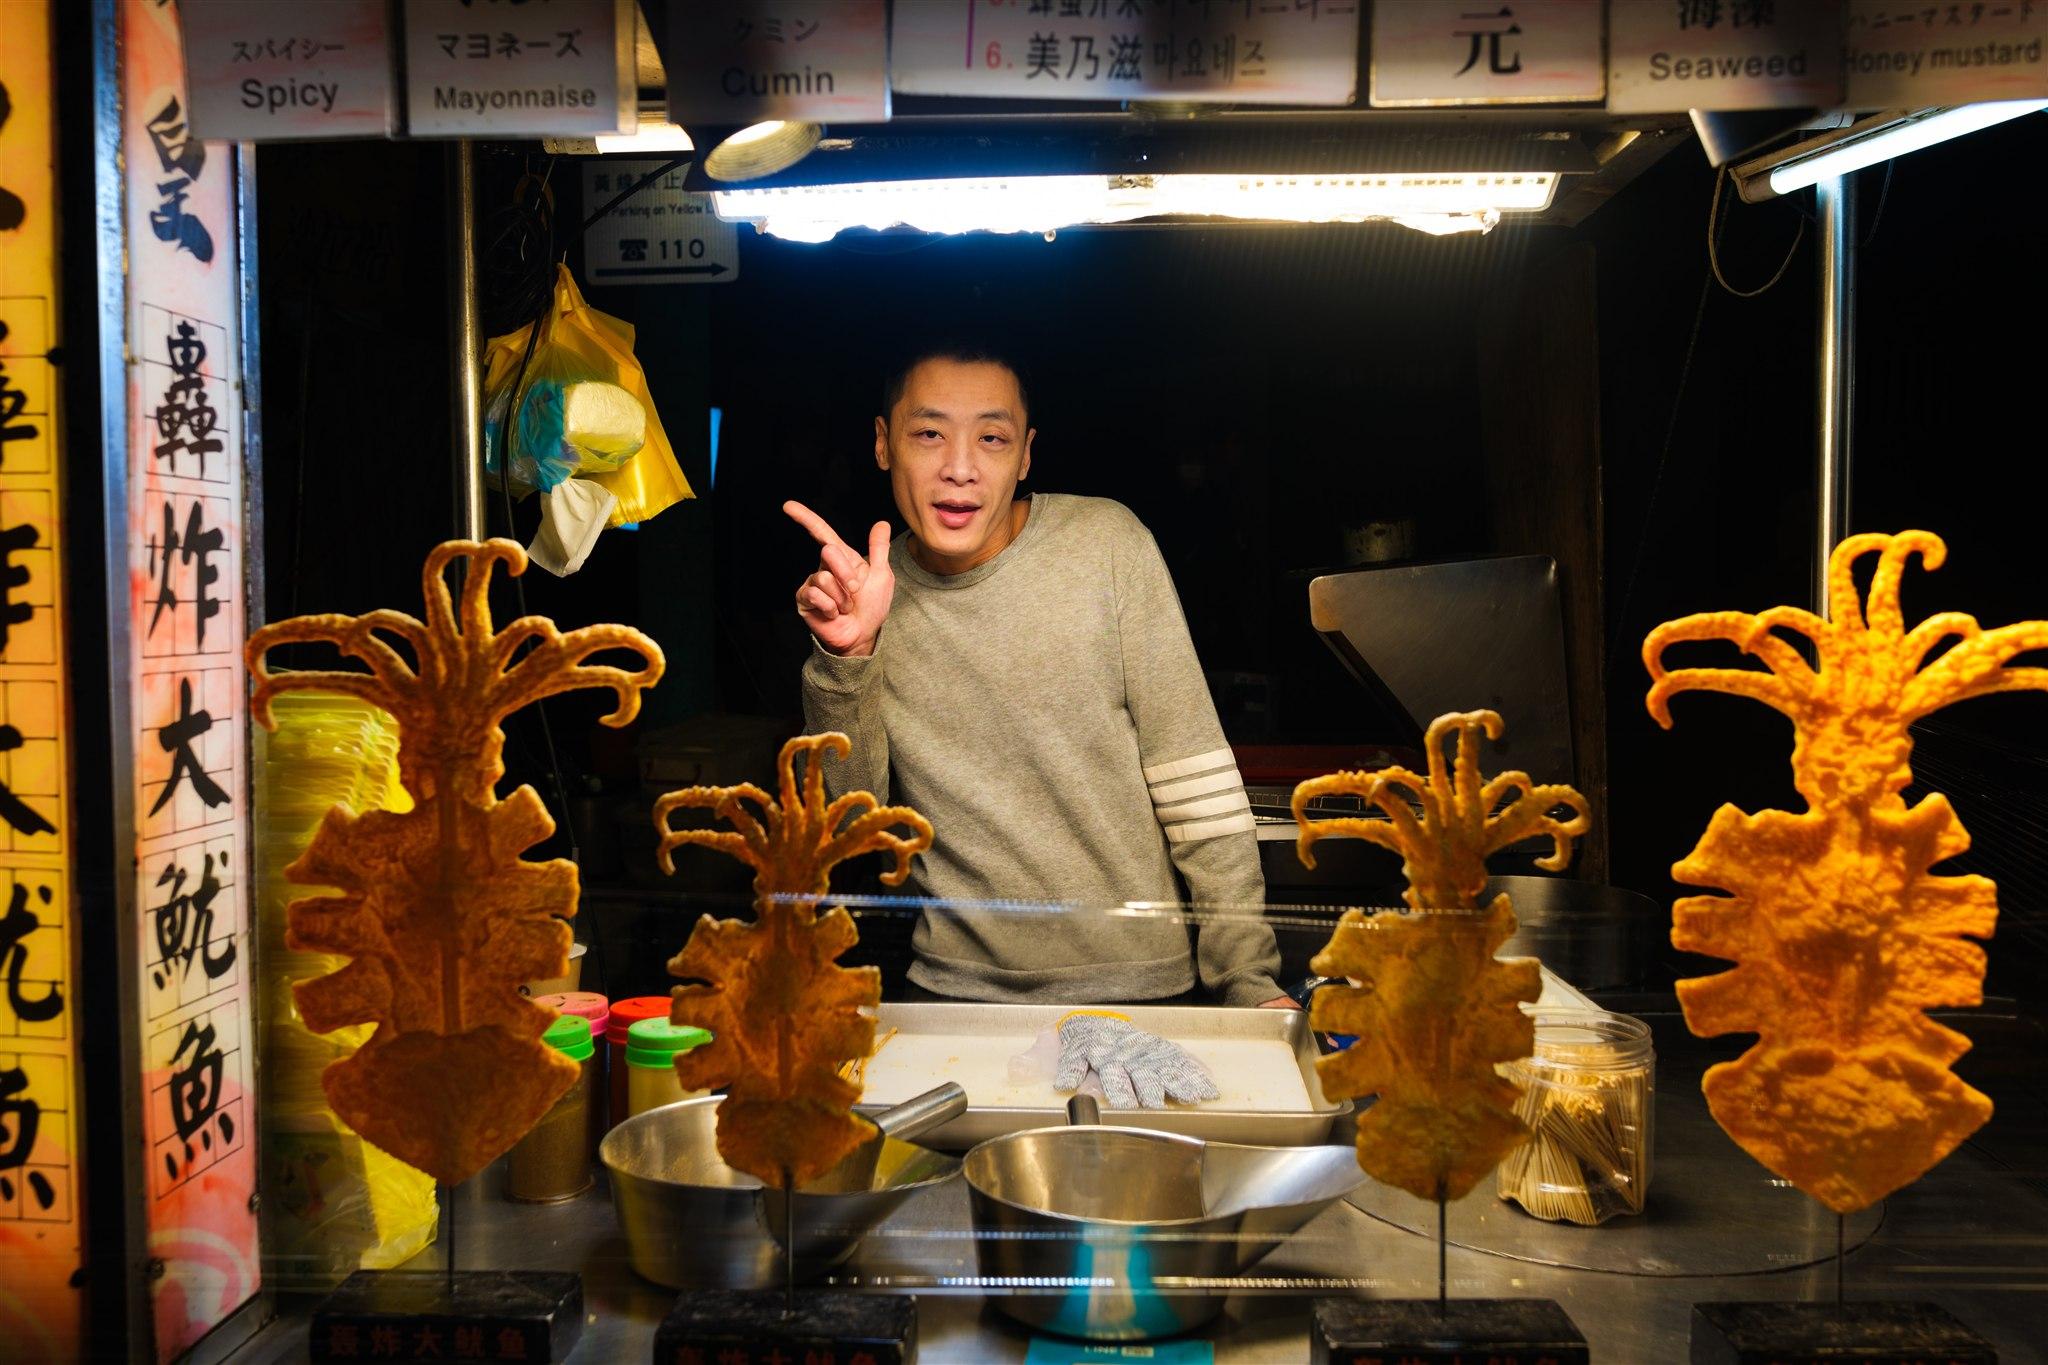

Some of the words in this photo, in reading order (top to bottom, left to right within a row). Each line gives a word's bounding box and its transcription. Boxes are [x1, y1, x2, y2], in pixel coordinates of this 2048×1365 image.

[437, 29, 582, 59] マヨネーズ
[732, 16, 820, 43] クミン
[1452, 9, 1521, 77] 元
[232, 38, 345, 63] スパイシー
[986, 41, 1013, 70] 6.
[1025, 33, 1142, 80] 美乃滋
[1154, 31, 1266, 82] 마요네즈
[1649, 49, 1807, 80] Seaweed
[1931, 37, 2041, 68] mustard
[241, 77, 338, 113] Spicy
[721, 65, 834, 97] Cumin
[434, 84, 597, 116] Mayonnaise
[659, 239, 704, 260] 110
[147, 320, 236, 1180] 轟炸大魷魚
